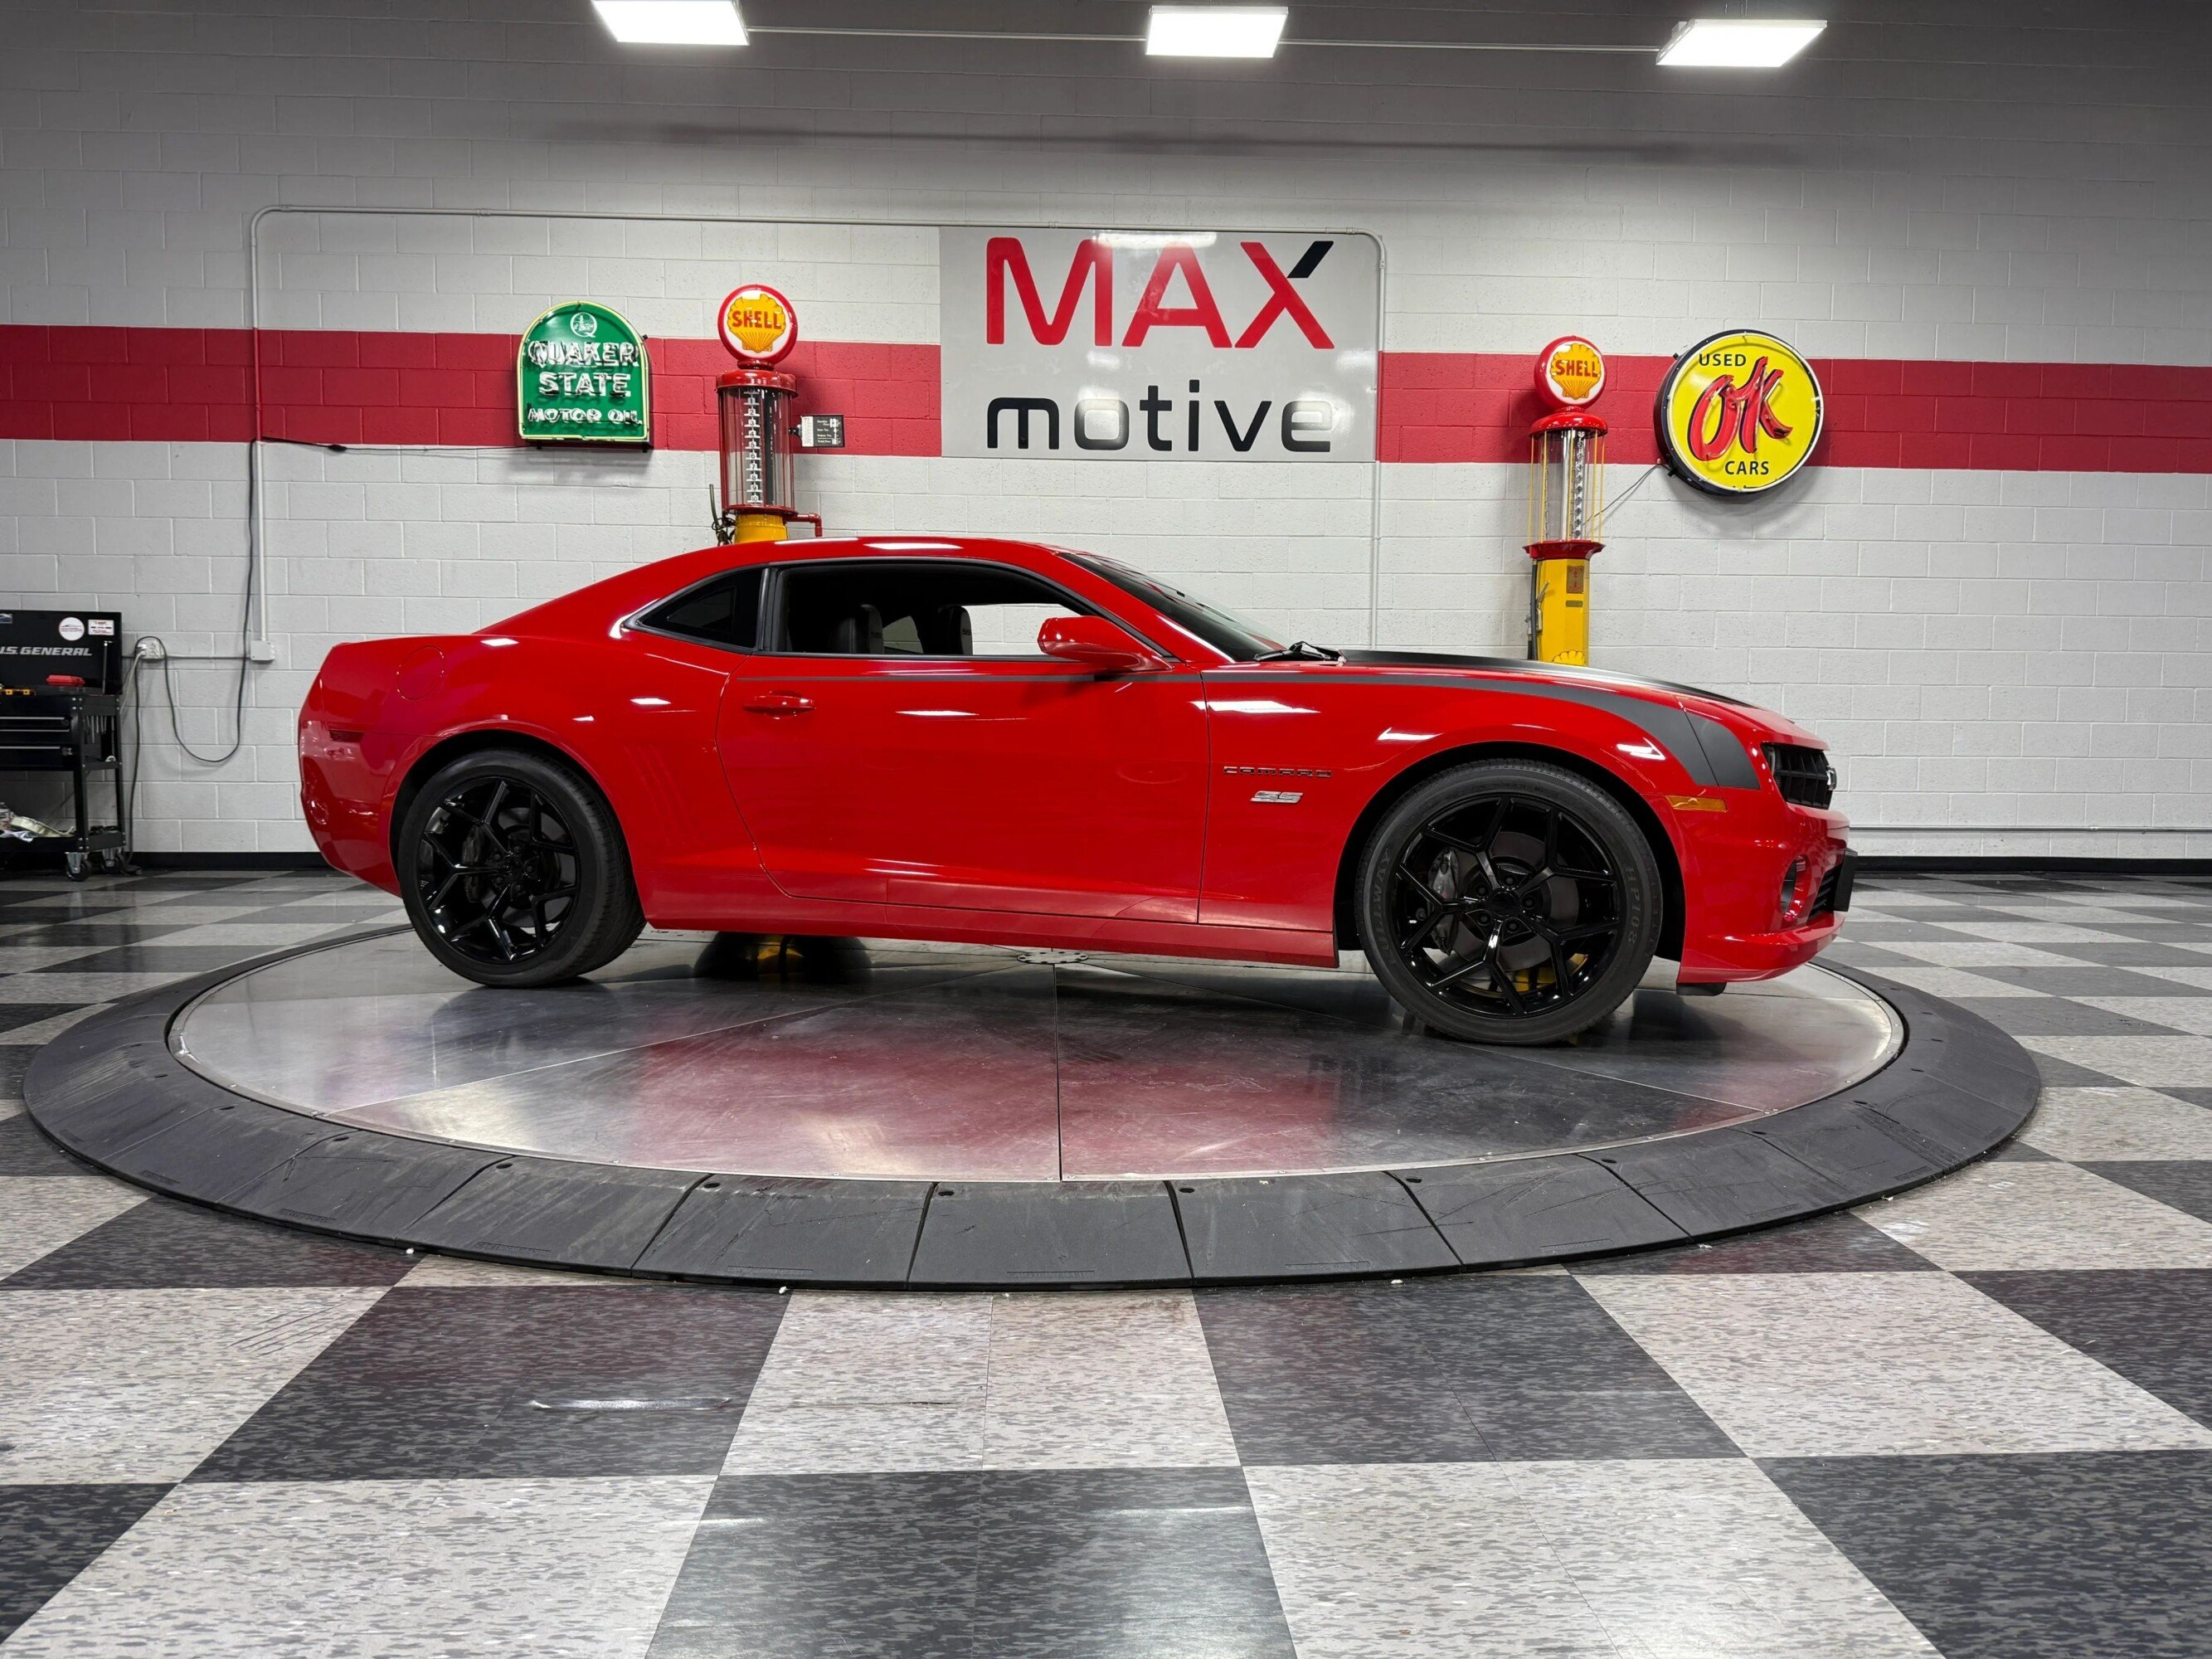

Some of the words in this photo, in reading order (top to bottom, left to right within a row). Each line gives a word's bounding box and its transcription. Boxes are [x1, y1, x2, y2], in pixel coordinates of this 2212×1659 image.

[986, 236, 1334, 349] MAX
[732, 310, 782, 329] SHELL
[527, 341, 639, 367] QUAKER
[1699, 353, 1747, 367] USED
[1555, 360, 1598, 377] SHELL
[539, 372, 632, 397] STATE
[527, 408, 602, 423] MOTOR
[986, 379, 1333, 453] motive
[1724, 460, 1770, 475] CARS
[20, 646, 93, 656] GENERAL
[1223, 766, 1332, 777] CAMARO
[1250, 790, 1304, 804] SS
